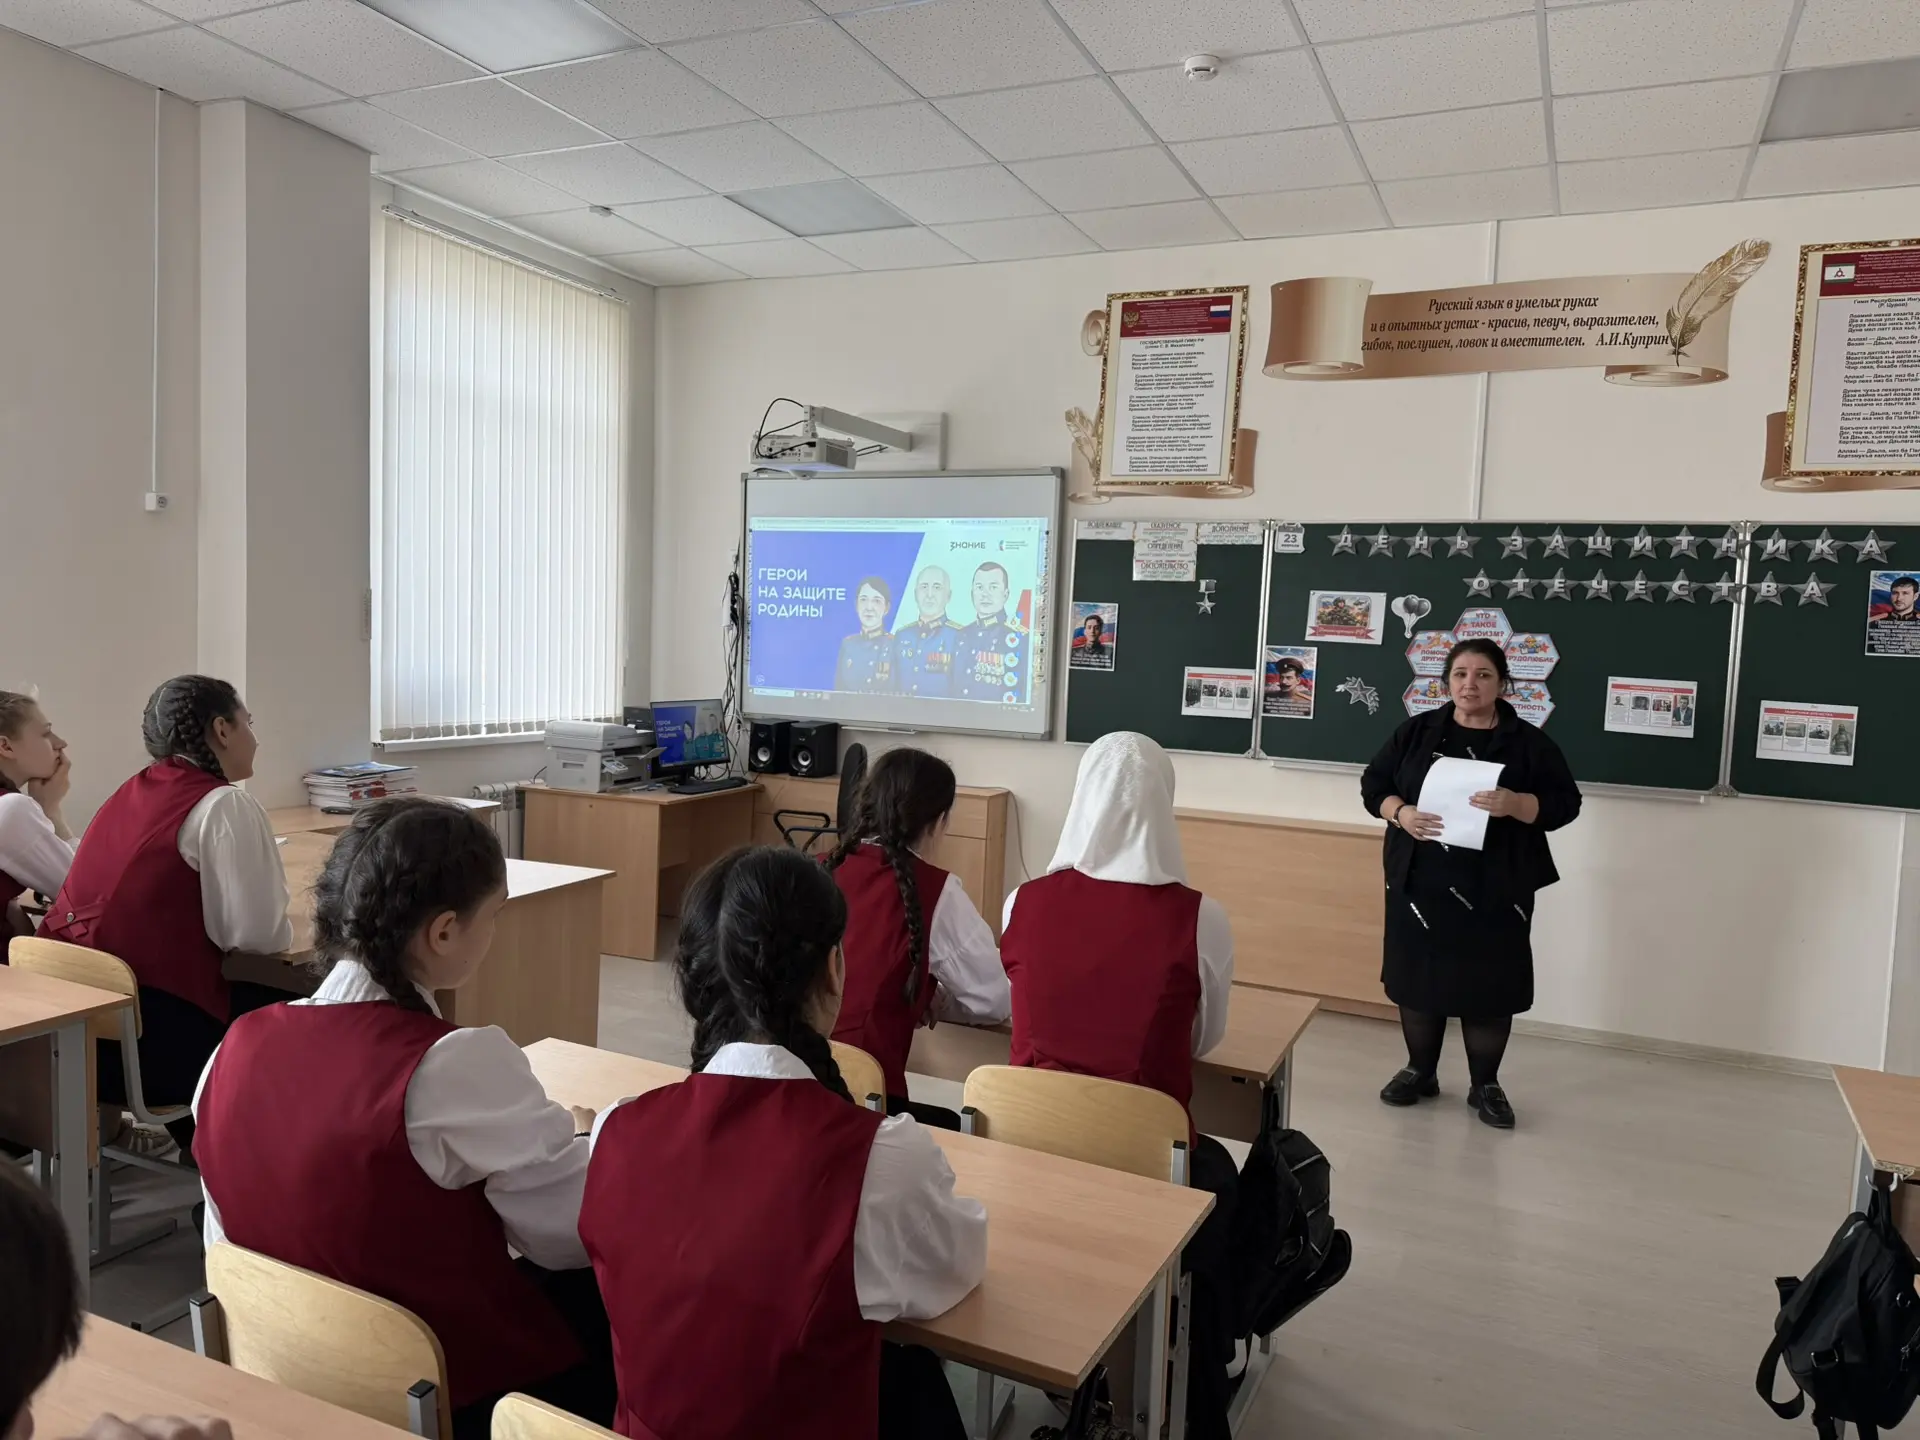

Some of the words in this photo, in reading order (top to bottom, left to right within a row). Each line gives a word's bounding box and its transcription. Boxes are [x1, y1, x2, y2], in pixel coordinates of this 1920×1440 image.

[1428, 297, 1474, 314] Русский
[1475, 299, 1504, 311] язык
[1507, 299, 1513, 308] в
[1515, 298, 1561, 312] умелых
[1562, 296, 1599, 311] руках
[1370, 322, 1377, 332] и
[1379, 322, 1386, 332] в
[1388, 320, 1441, 332] опытных
[1444, 318, 1480, 333] устах
[1488, 317, 1530, 332] красив,
[1533, 317, 1570, 330] певуч,
[1573, 315, 1659, 331] выразителен,
[1361, 338, 1394, 352] гибок,
[1397, 339, 1453, 352] послушен,
[1455, 338, 1488, 348] ловок
[1491, 338, 1498, 347] и
[1501, 335, 1585, 348] вместителен.
[1284, 533, 1297, 543] 23
[1339, 533, 1469, 549] ДЕНЬ
[1510, 534, 1882, 554] ЗАЩИТНИКА
[758, 567, 807, 581] ГЕРОИ
[758, 585, 778, 599] НА
[783, 586, 846, 602] ЗАЩИТЕ
[1473, 576, 1824, 597] ОТЕЧЕСТВА
[758, 602, 823, 618] РОДИНЫ
[1512, 703, 1547, 711] СТНОСТЬ
